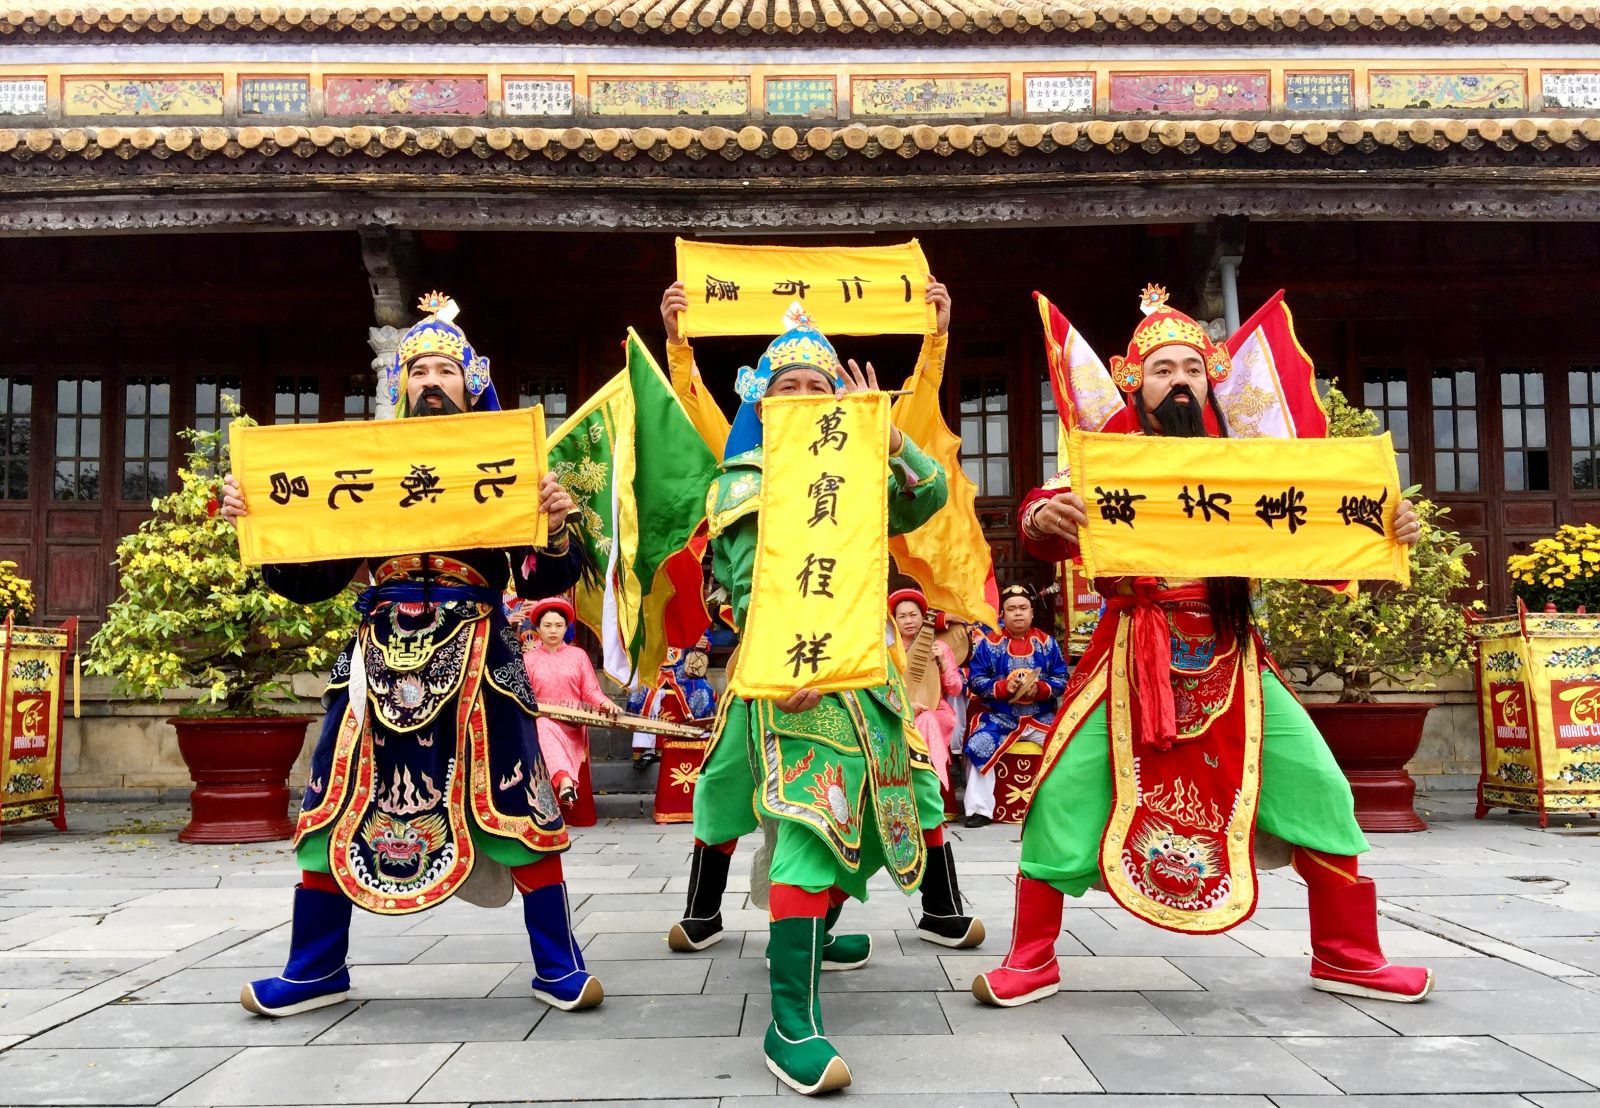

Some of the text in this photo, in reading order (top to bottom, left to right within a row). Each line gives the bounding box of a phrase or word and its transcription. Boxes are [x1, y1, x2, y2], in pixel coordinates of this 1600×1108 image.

[704, 273, 913, 304] 一仁有慶
[1093, 483, 1389, 538] 群芳集慶
[784, 406, 849, 679] 萬寶程祥
